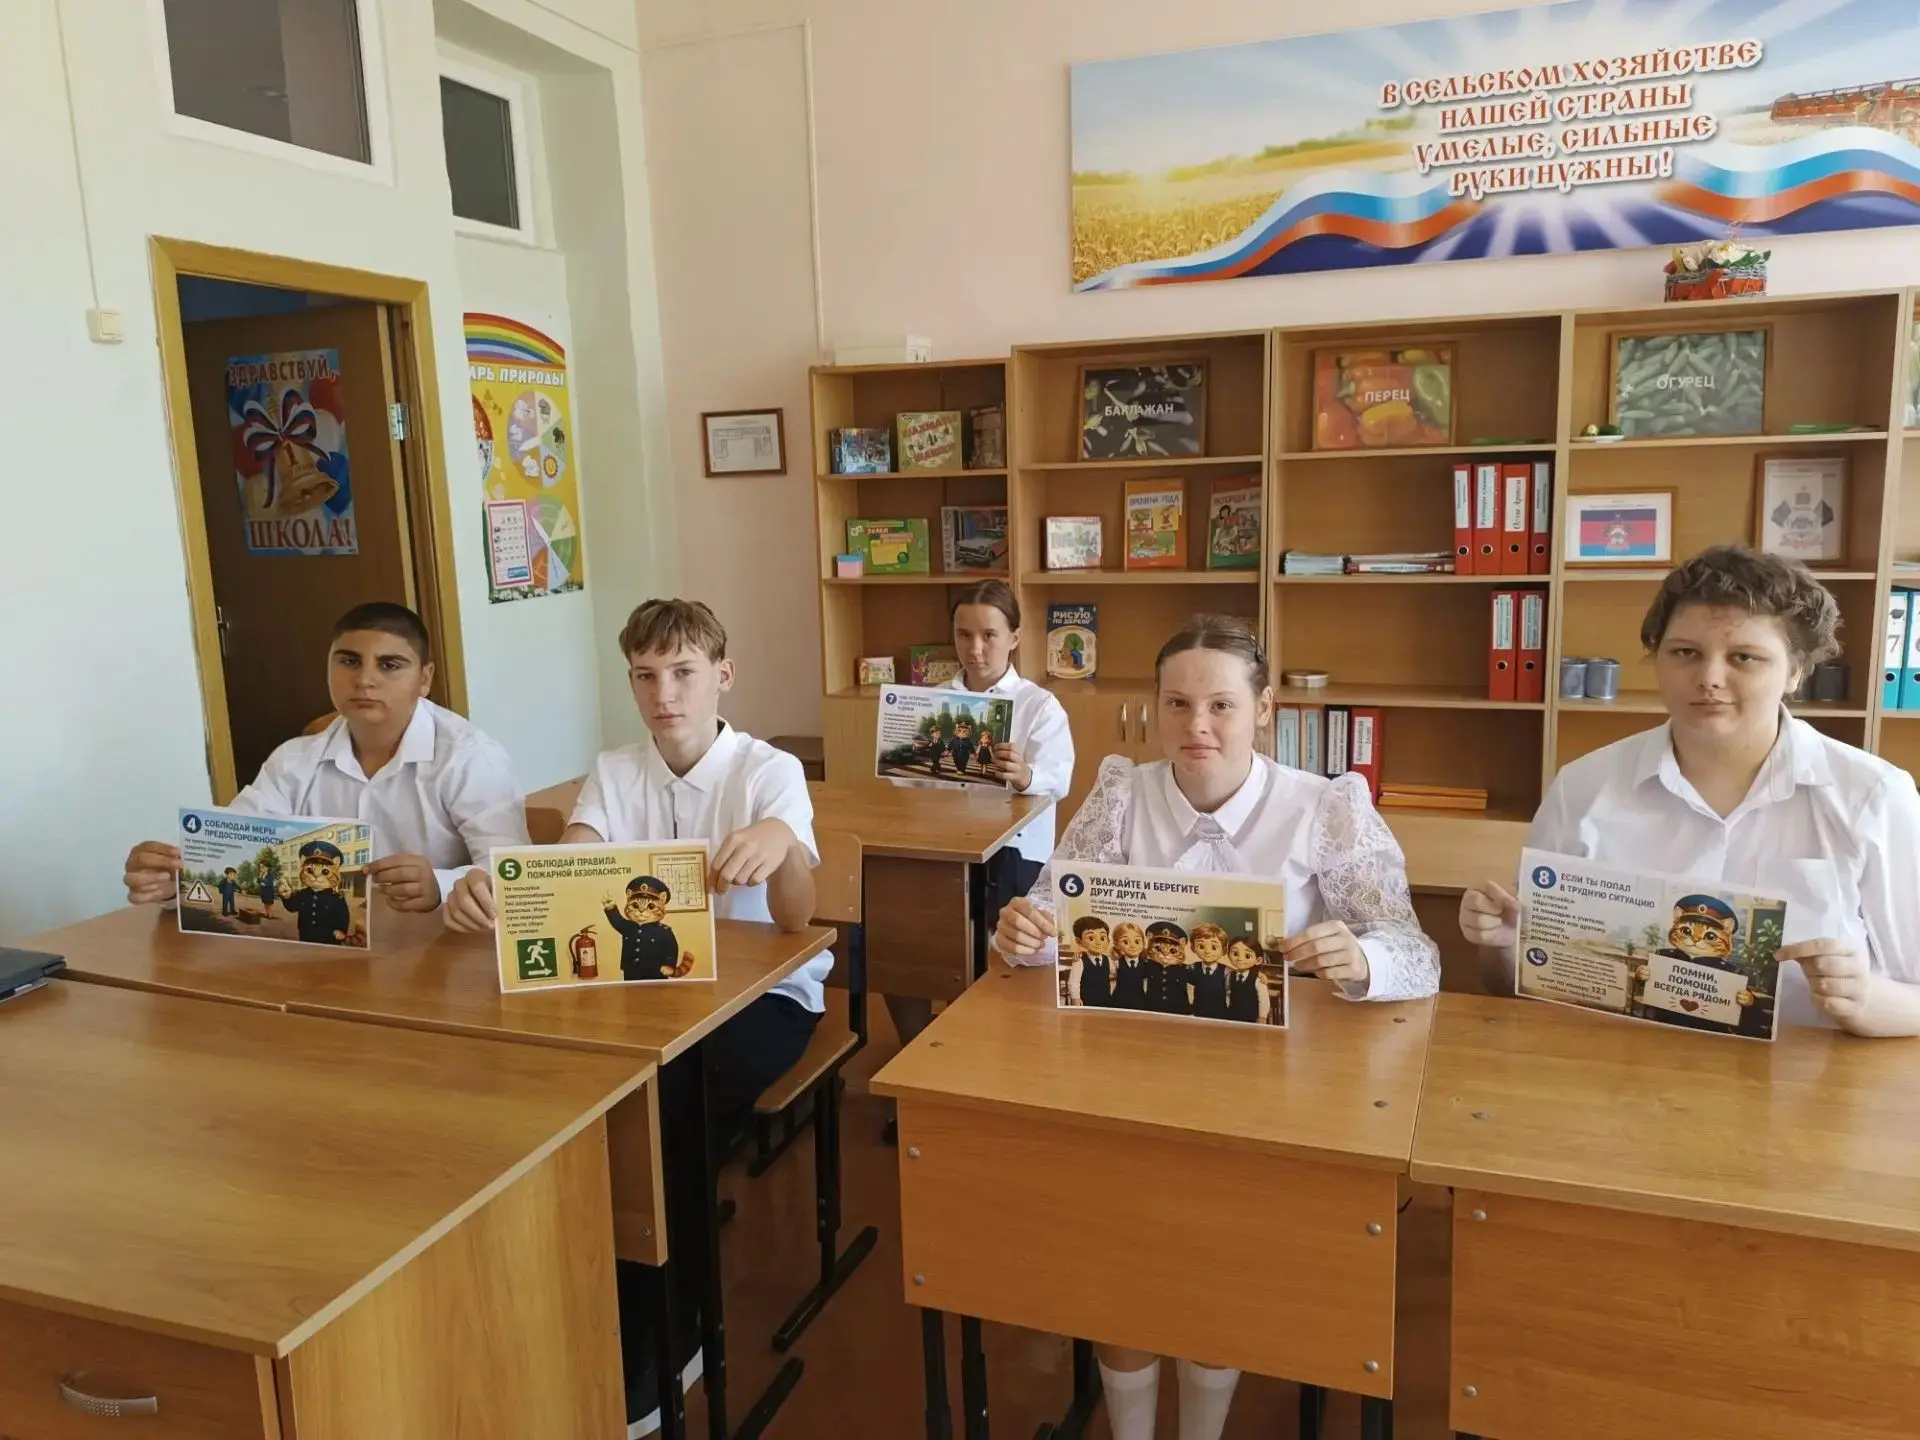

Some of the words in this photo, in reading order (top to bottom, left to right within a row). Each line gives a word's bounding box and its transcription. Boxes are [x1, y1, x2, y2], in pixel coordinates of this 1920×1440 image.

[1381, 84, 1397, 104] В
[1405, 65, 1562, 98] СЕЛЬСКОМ
[1573, 41, 1759, 82] ХОЗЯЙСТВЕ
[1440, 94, 1547, 130] НАШЕЙ
[1557, 84, 1688, 117] СТРАНЫ
[1416, 132, 1553, 168] УМЕЛЫЕ,
[1562, 115, 1713, 149] СИЛЬНЫЕ
[1453, 168, 1527, 196] РУКИ
[500, 368, 564, 386] ПРИРОДЫ
[1656, 376, 1715, 389] ОГУРЕЦ
[1364, 388, 1410, 402] ПЕРЕЦ
[1105, 403, 1174, 417] БАКЛАЖАН
[250, 518, 351, 548] ШКОЛА!
[1053, 611, 1091, 619] РИСУЮ
[1887, 634, 1900, 653] 7
[187, 817, 197, 832] 4
[204, 819, 250, 832] СОБЛЮДАЙ
[252, 825, 276, 835] МЕРЫ
[204, 829, 284, 845] ПРЕДОСТОРОЖНОСТИ
[505, 862, 516, 878] 5
[526, 857, 575, 869] СОБЛЮДАЙ
[577, 856, 617, 867] ПРАВИЛА
[527, 869, 572, 879] ПОЖАРНОЙ
[574, 867, 632, 878] БЕЗОПАСНОСТИ
[1539, 870, 1550, 886] 8
[1065, 877, 1077, 893] 6
[1089, 876, 1141, 889] УВАЖАЙТЕ
[1144, 881, 1151, 890] И
[1153, 882, 1200, 895] БЕРЕГИТЕ
[1561, 873, 1583, 884] ЕСЛИ
[1586, 877, 1598, 886] ТЫ
[1600, 880, 1631, 892] ПОПАЛ
[1090, 888, 1114, 897] ДРУГ
[1116, 890, 1147, 900] ДРУГА
[1560, 884, 1565, 892] В
[1568, 885, 1607, 899] ТРУДНУЮ
[1609, 893, 1655, 908] СИТУАЦИЮ
[1672, 965, 1717, 984] ПОМНИ,
[1668, 975, 1718, 993] ПОМОЩЬ
[1654, 981, 1690, 997] ВСЕГДА
[1692, 991, 1731, 1006] РЯДОМ!
